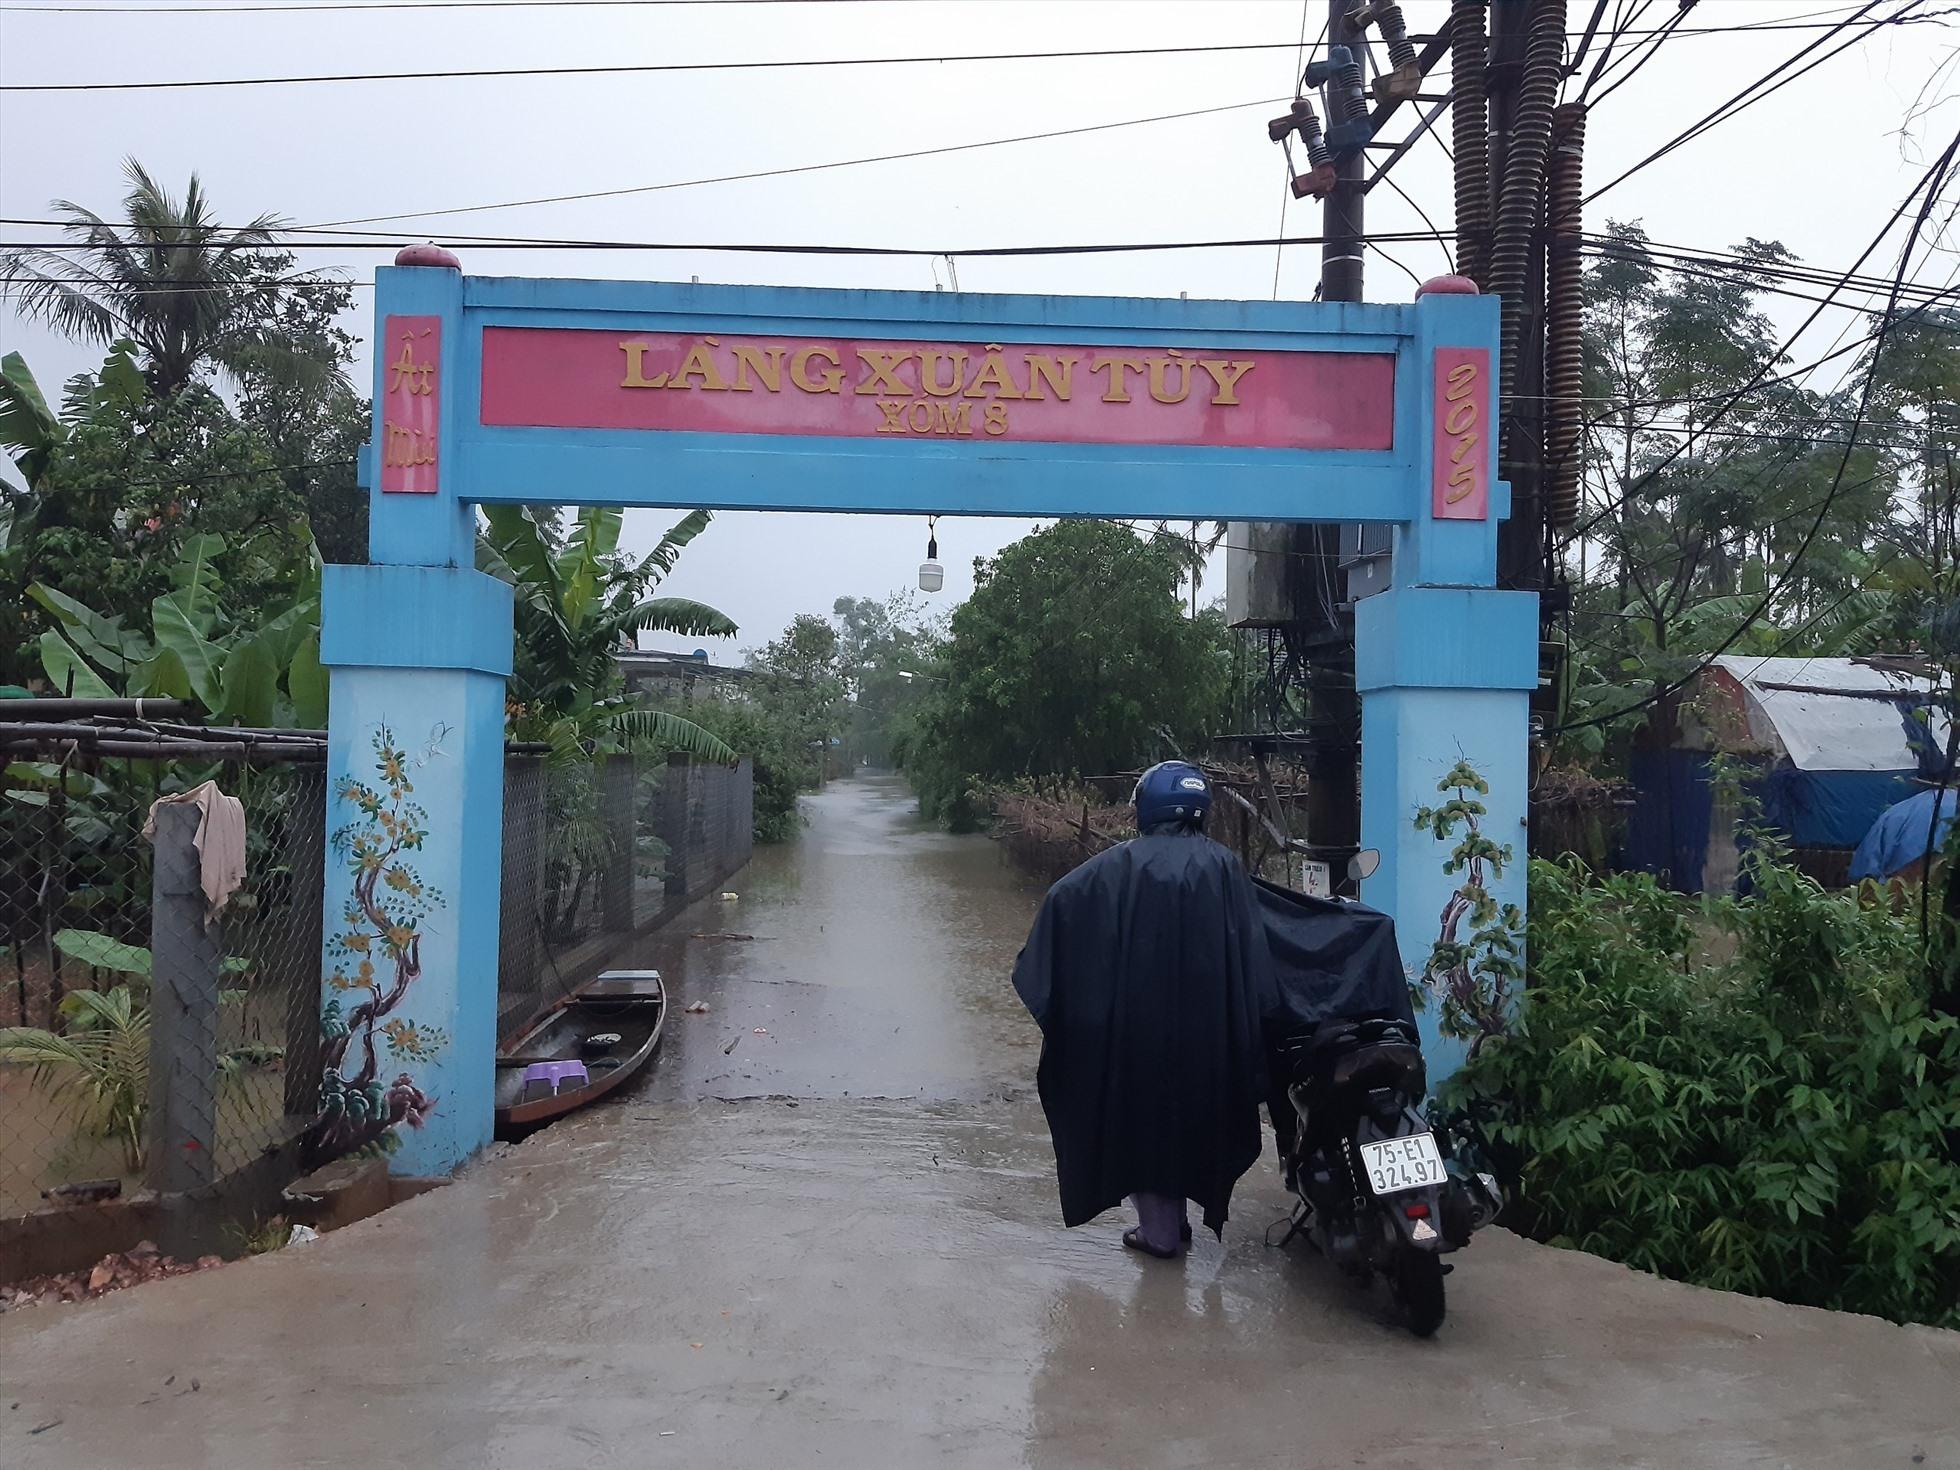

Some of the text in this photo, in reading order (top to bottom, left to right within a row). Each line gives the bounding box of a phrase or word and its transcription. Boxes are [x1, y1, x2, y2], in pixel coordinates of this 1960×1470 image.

[619, 335, 1255, 405] LÀNG XUÂN TÙY
[984, 401, 1009, 435] 8
[1445, 363, 1478, 504] 2015
[1373, 1139, 1424, 1166] 75-E1
[1374, 1159, 1437, 1189] 324.97
